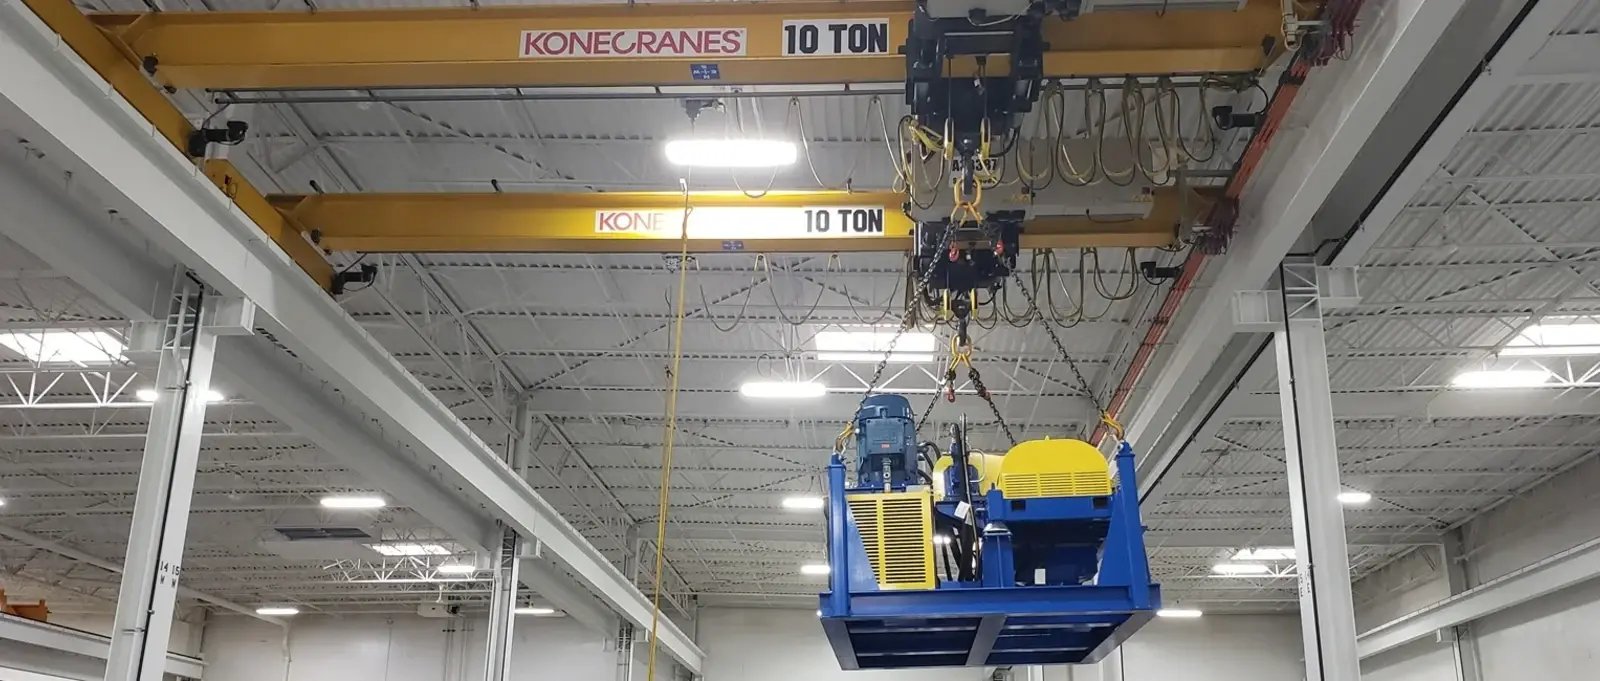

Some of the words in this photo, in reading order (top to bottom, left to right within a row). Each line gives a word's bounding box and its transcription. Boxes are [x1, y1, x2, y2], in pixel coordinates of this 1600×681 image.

[524, 30, 741, 55] KONECRANES
[784, 24, 819, 54] 10
[828, 23, 888, 53] TON
[804, 209, 830, 233] 10
[837, 208, 883, 233] TON
[160, 560, 169, 572] 14
[171, 565, 180, 576] 15
